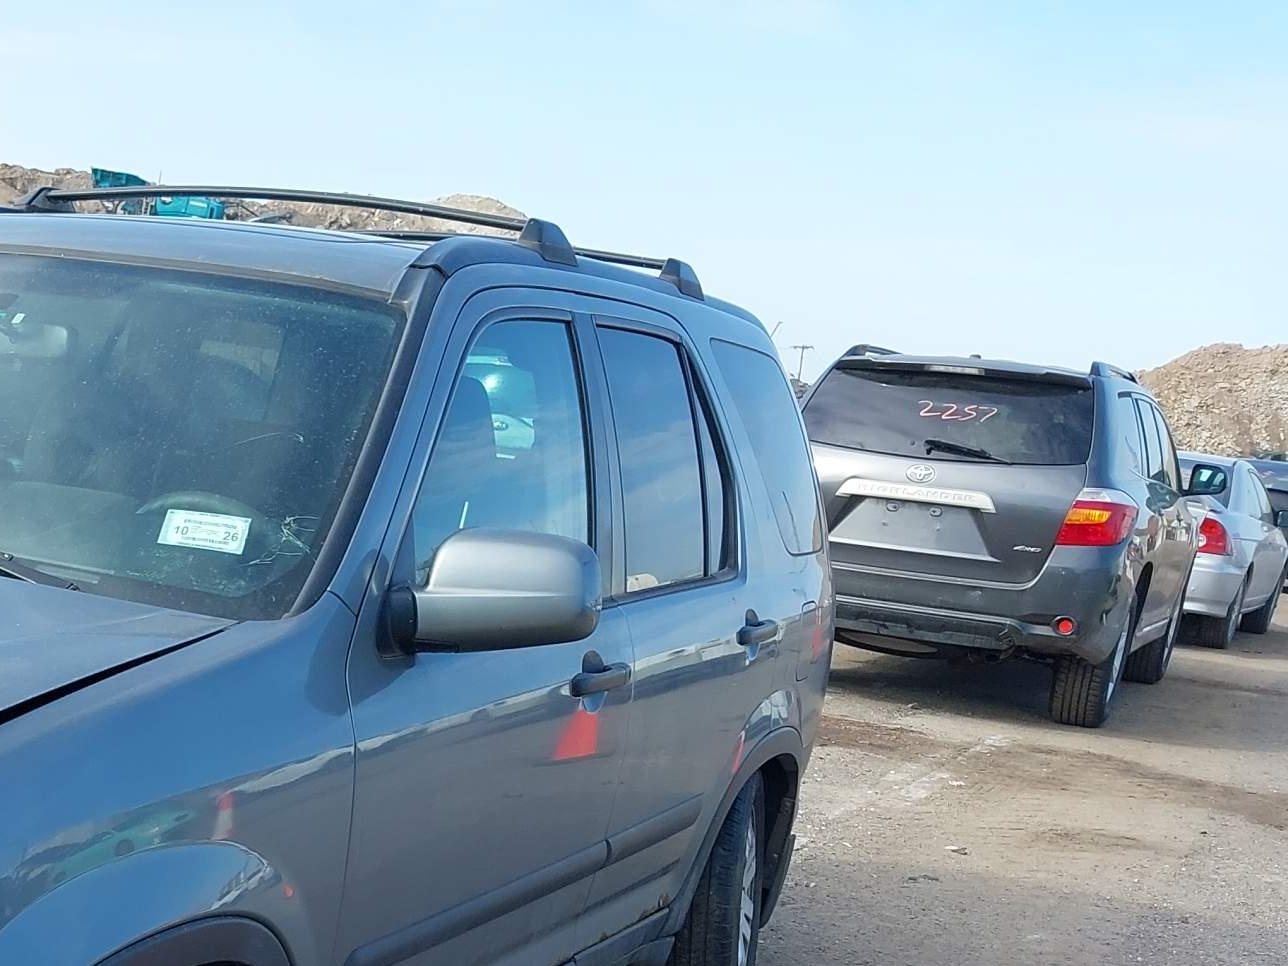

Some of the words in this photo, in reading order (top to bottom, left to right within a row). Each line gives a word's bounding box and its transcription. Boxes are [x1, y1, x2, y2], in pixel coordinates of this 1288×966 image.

[917, 400, 998, 422] 2257
[175, 525, 189, 536] 10
[223, 531, 240, 542] 26
